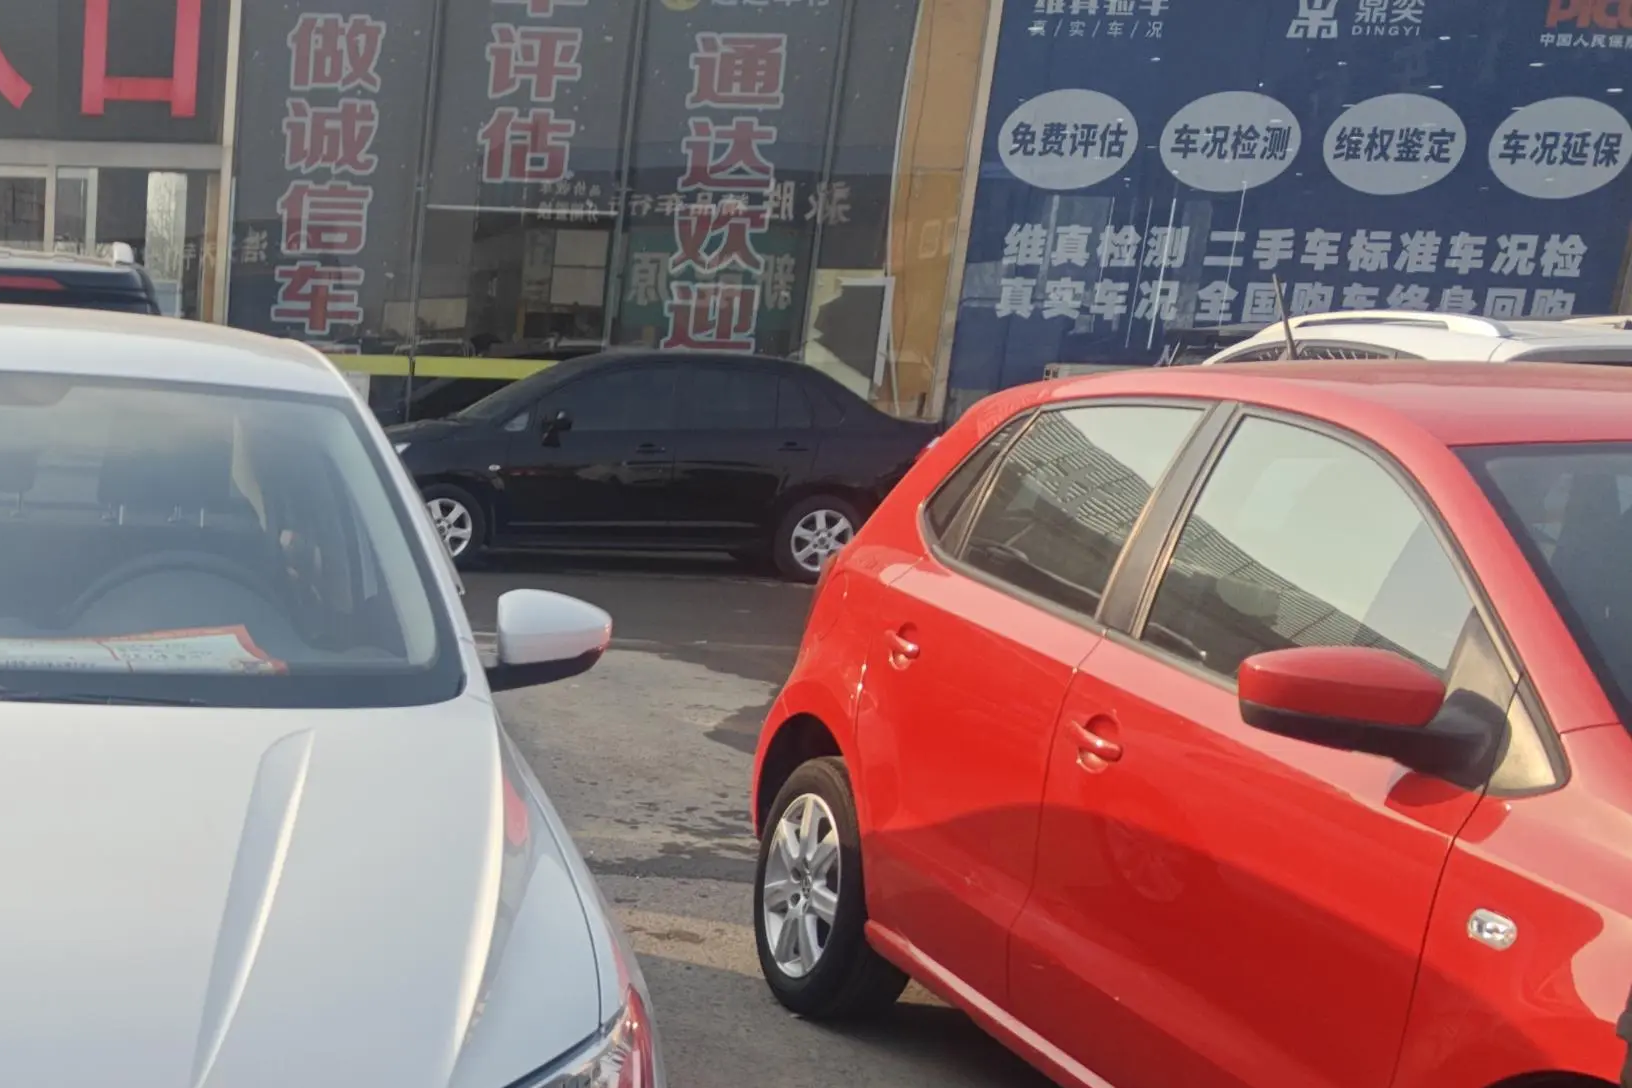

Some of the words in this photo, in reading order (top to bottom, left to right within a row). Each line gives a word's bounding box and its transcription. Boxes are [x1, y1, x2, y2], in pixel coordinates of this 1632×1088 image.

[1351, 25, 1420, 36] DINGYI
[477, 0, 583, 184] 评估
[1010, 121, 1129, 160] 免费评估
[1170, 123, 1293, 162] 车况检测
[1333, 126, 1456, 164] 维权鉴定
[1498, 129, 1623, 168] 车况延保
[270, 13, 386, 354] 做诚信车
[662, 31, 787, 353] 通达欢迎
[1003, 223, 1190, 268] 维真检测
[1203, 228, 1589, 278] 二手车标准车况检
[995, 276, 1182, 321] 真实车况
